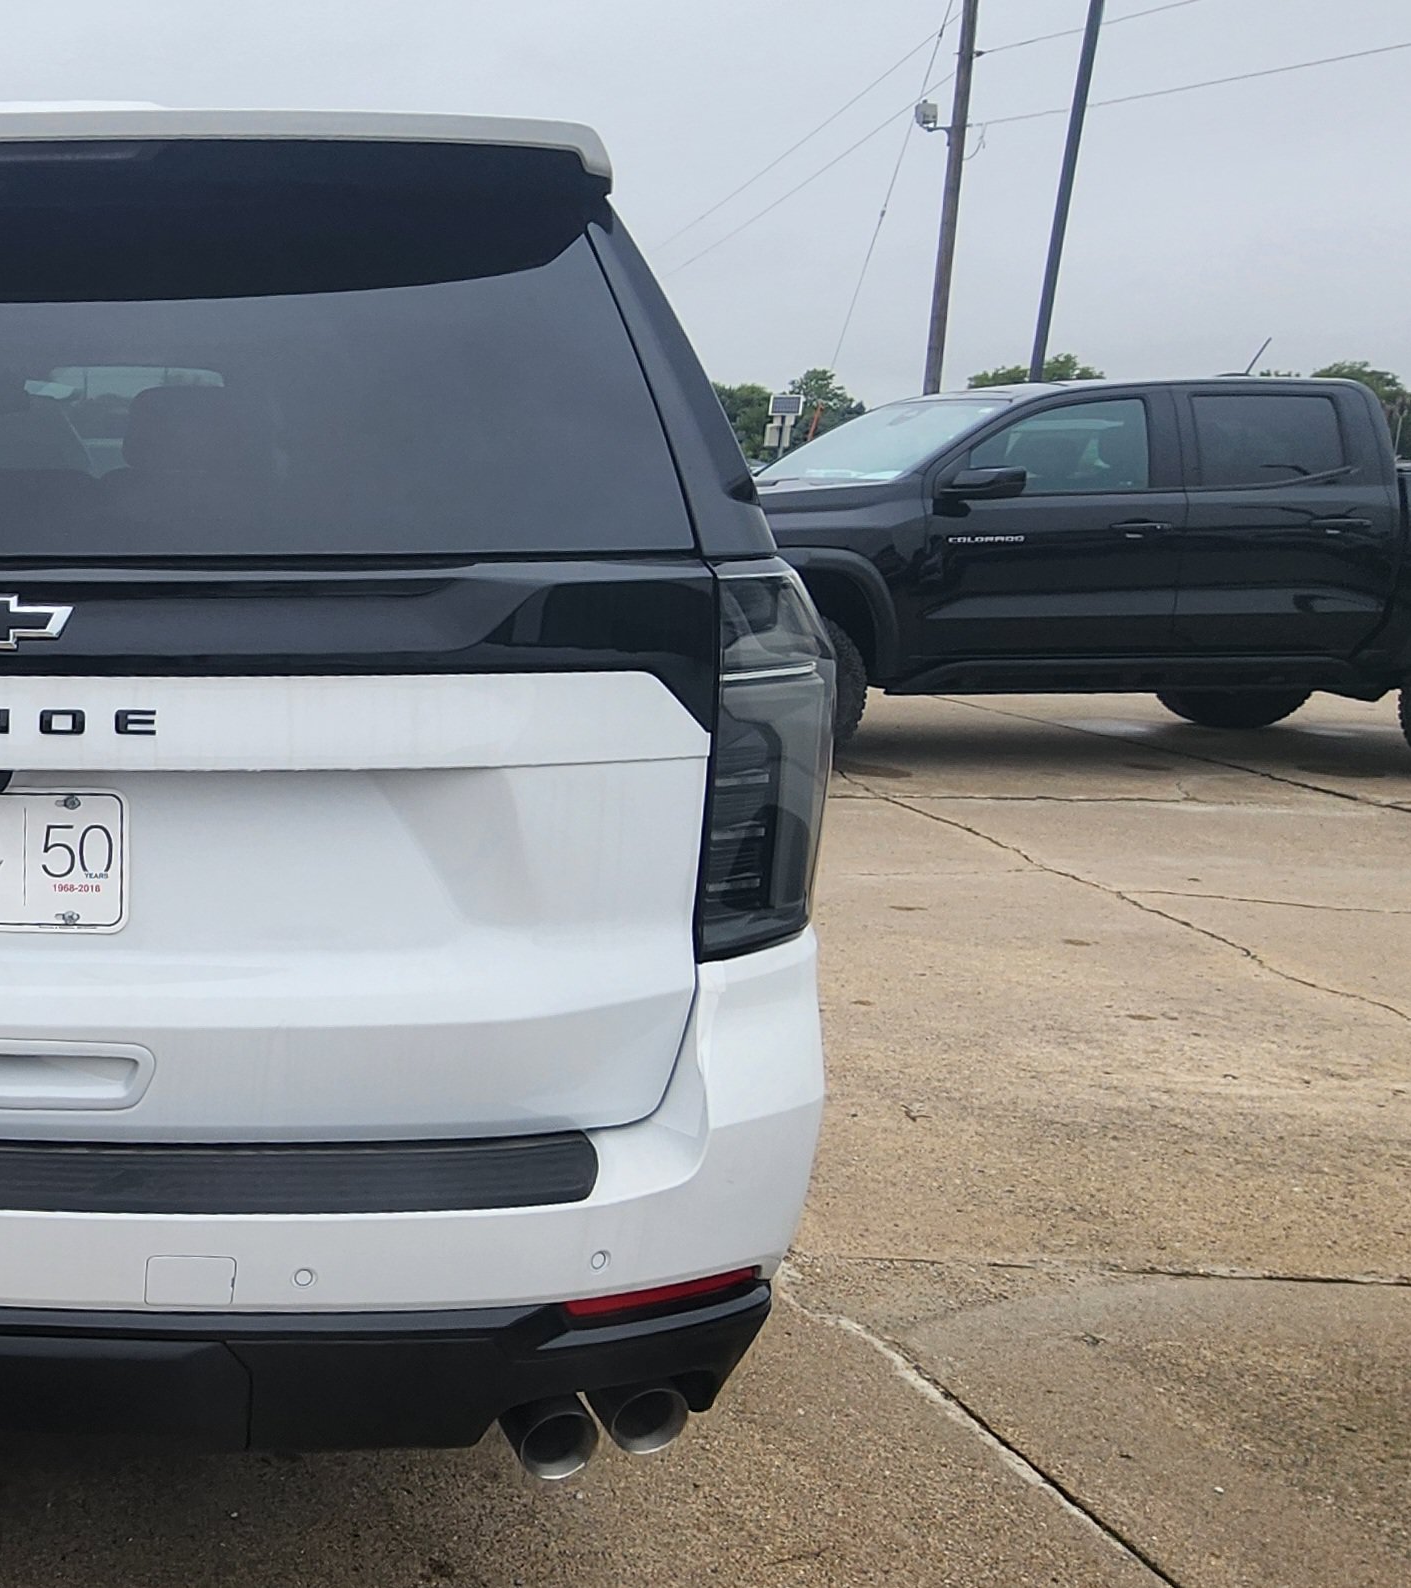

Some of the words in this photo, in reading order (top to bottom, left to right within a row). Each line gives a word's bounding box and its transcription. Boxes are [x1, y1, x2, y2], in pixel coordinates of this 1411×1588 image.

[948, 535, 1025, 544] COLORADO
[41, 824, 114, 878] 50
[84, 872, 109, 880] YEARS
[52, 883, 101, 893] 1968-2018
